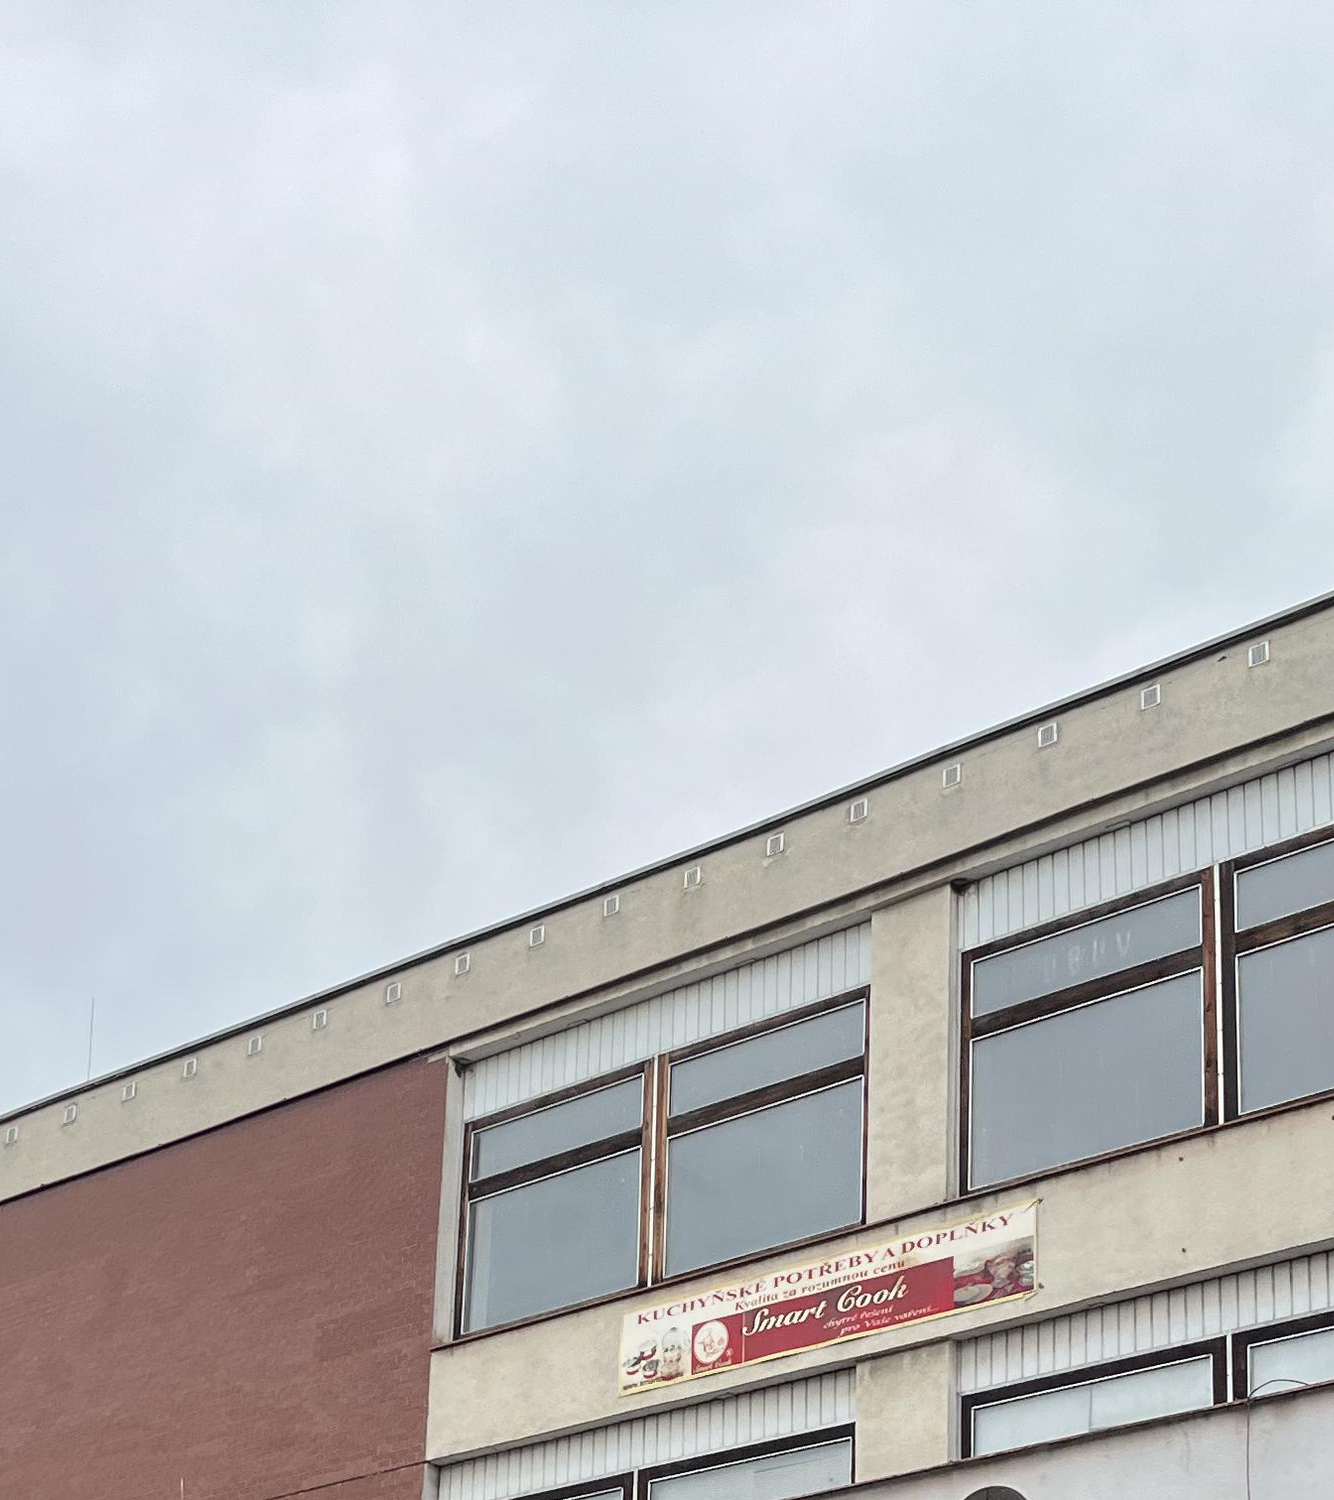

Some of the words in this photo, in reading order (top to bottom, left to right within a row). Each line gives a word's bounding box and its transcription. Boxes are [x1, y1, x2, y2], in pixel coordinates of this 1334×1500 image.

[637, 1281, 767, 1325] KUCHYŇSKÉ
[773, 1250, 879, 1288] POTŘEBY
[883, 1247, 895, 1258] A
[901, 1213, 1013, 1255] DOPLŇKY
[735, 1292, 778, 1311] Kvalita
[782, 1287, 797, 1299] za
[801, 1269, 868, 1294] rozumnou
[868, 1260, 905, 1276] cenu
[742, 1300, 828, 1336] Smart
[837, 1275, 909, 1312] Cook
[838, 1322, 860, 1337] pro
